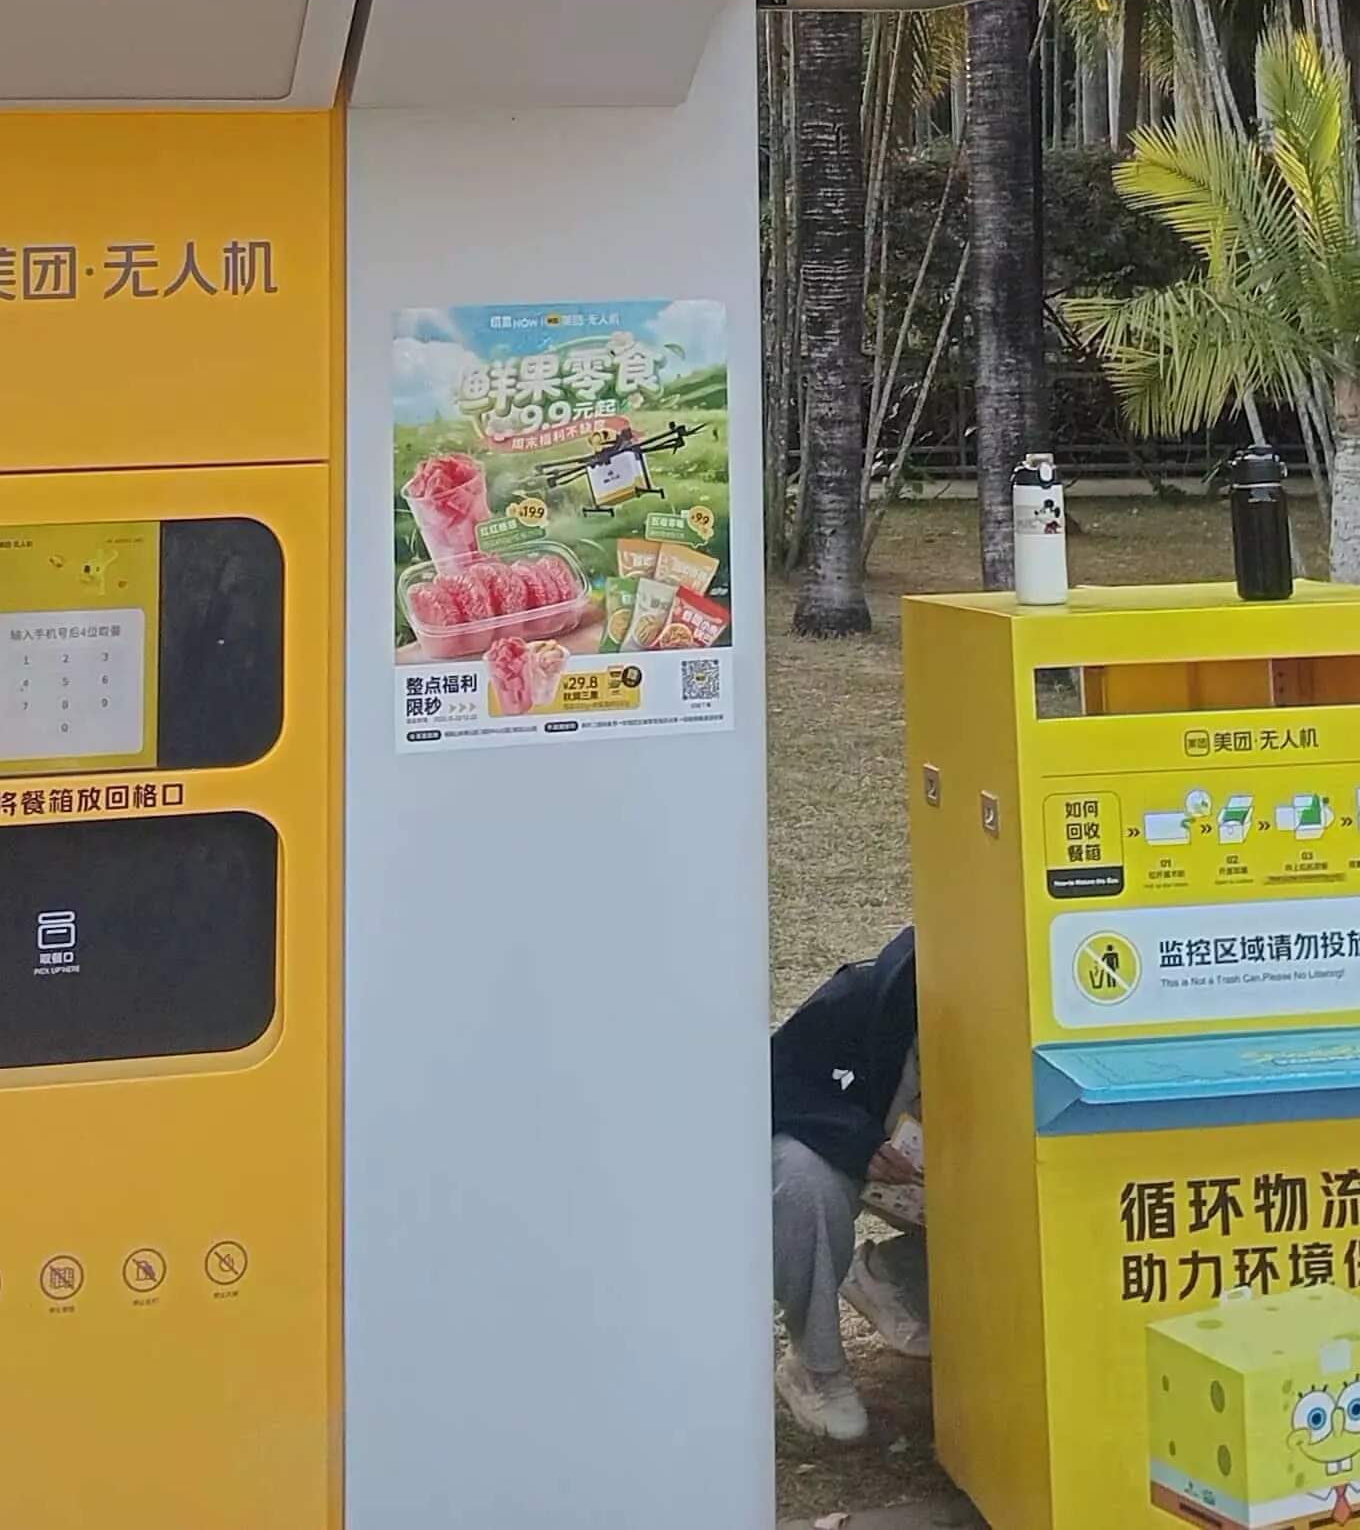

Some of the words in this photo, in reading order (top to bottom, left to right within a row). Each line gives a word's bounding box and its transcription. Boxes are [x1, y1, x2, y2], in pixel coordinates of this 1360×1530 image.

[461, 342, 664, 412] 鲜果零食
[406, 675, 477, 696] 整点福利
[406, 697, 442, 717] 限秒
[1213, 728, 1319, 752] 美团·无人机
[1065, 801, 1099, 818] 如何
[1067, 823, 1100, 840] 回收
[1067, 844, 1101, 862] 餐箱
[1160, 978, 1180, 988] This
[1293, 971, 1307, 979] No
